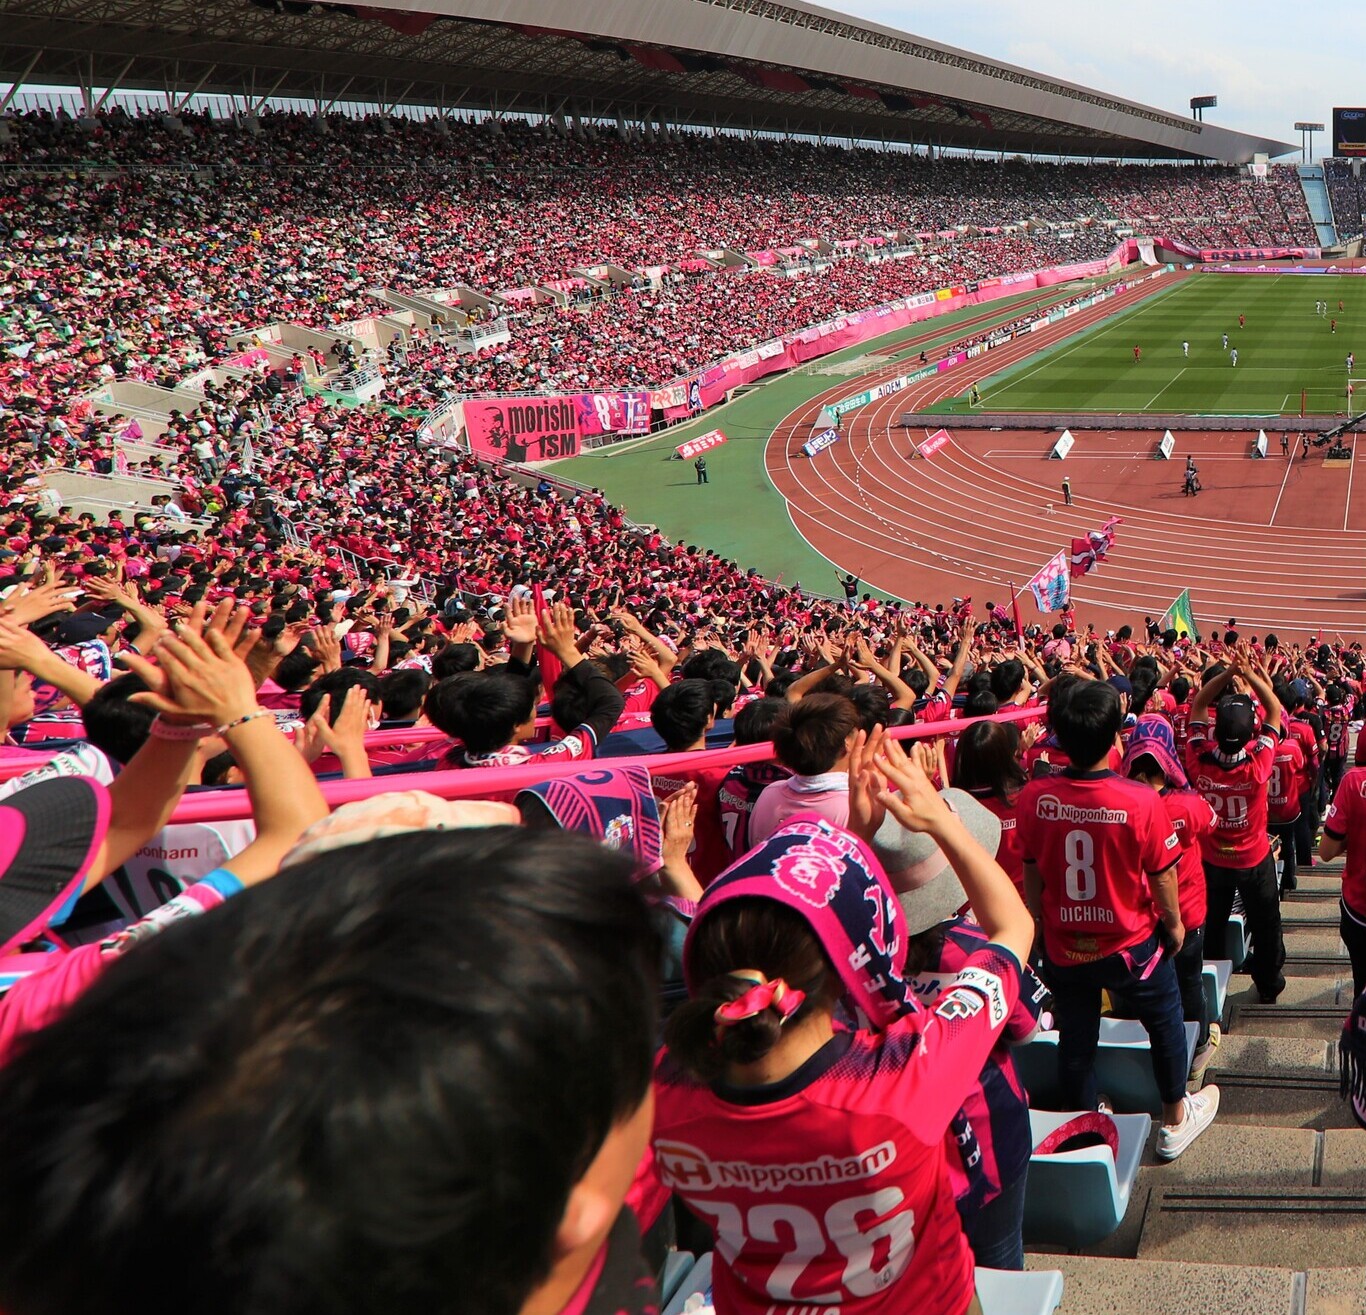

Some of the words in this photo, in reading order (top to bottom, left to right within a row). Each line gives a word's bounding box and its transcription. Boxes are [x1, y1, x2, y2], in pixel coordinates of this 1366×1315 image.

[1211, 250, 1266, 261] OSAKA
[508, 398, 575, 435] morishi
[593, 394, 612, 431] 8
[1329, 723, 1343, 742] 8
[1060, 805, 1126, 824] Nipponham
[1064, 829, 1097, 901] 8
[717, 1145, 894, 1189] Nipponham
